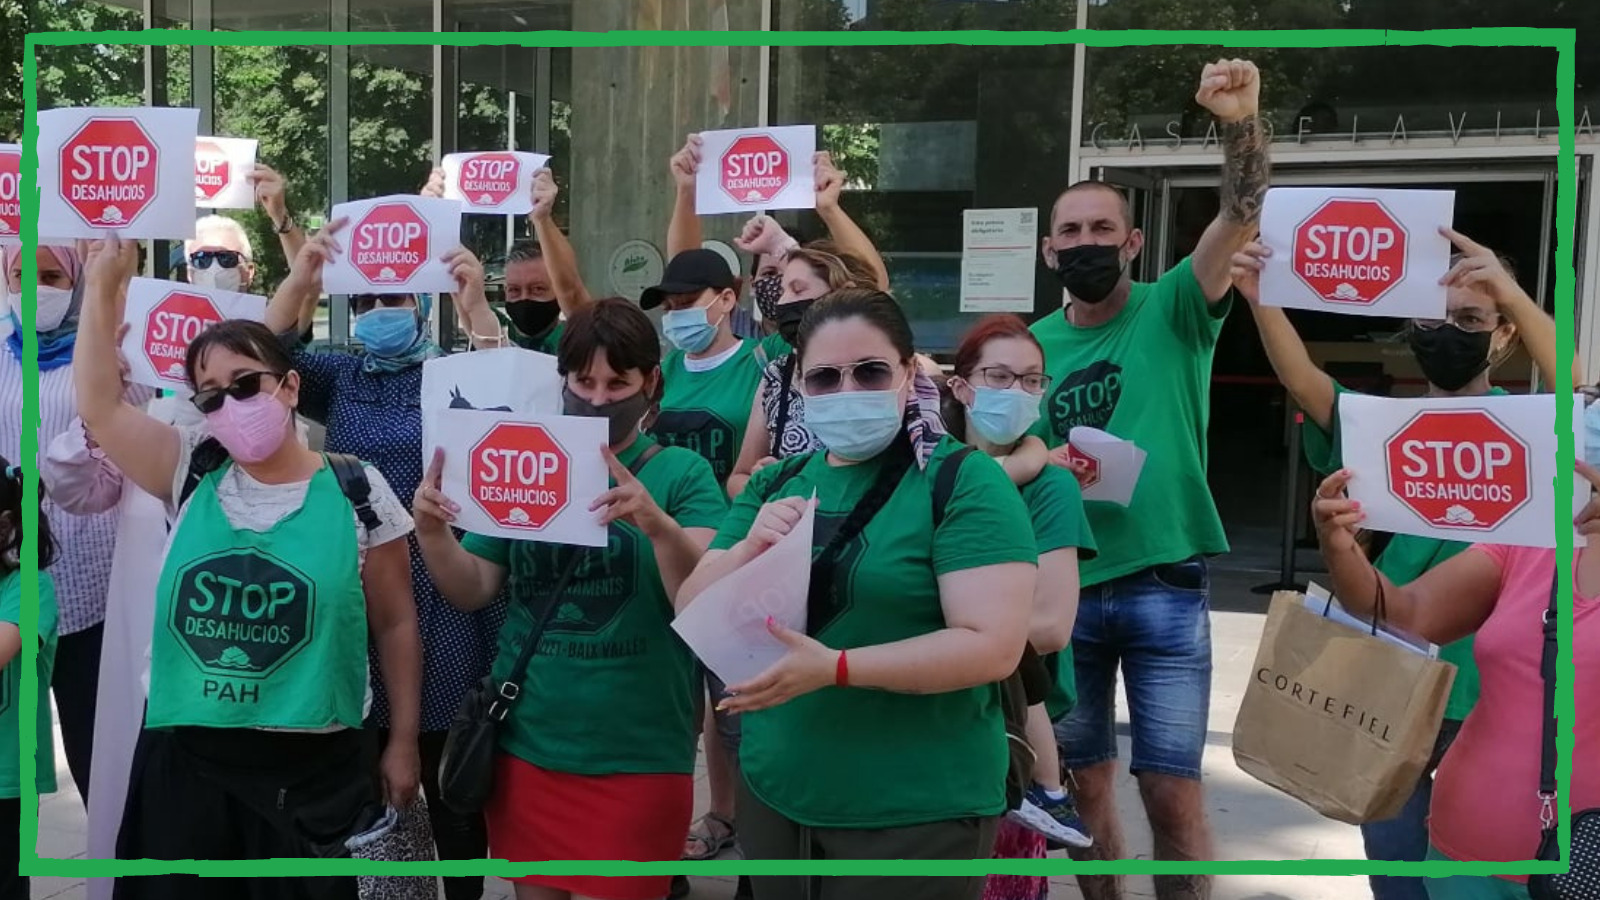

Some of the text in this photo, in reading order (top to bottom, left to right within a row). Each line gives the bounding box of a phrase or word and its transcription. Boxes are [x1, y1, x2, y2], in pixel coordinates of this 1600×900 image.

[1091, 119, 1222, 152] CASA
[71, 145, 150, 181] STOP
[195, 153, 224, 174] OP
[465, 159, 515, 180] STOP
[727, 150, 782, 177] STOP
[71, 184, 146, 201] DESAHUCIOS
[464, 180, 511, 192] DESAHUCIOS
[727, 176, 782, 190] DESAHUCIOS
[358, 222, 422, 250] STOP
[1304, 224, 1395, 261] STOP
[357, 251, 419, 265] DESAHUCIOS
[1304, 262, 1391, 282] DESAHUCIOS
[150, 342, 186, 361] DESAH
[1055, 372, 1122, 420] STOP
[649, 428, 725, 459] TOP
[480, 447, 559, 486] STOP
[1401, 439, 1513, 481] STOP
[480, 485, 557, 507] DESAHUCIOS
[1404, 481, 1513, 503] DESAHUCIOS
[188, 570, 296, 619] STOP
[184, 616, 291, 644] DESAHUCIOS
[203, 679, 260, 704] PAH
[1256, 667, 1391, 743] CORTEFIEL
